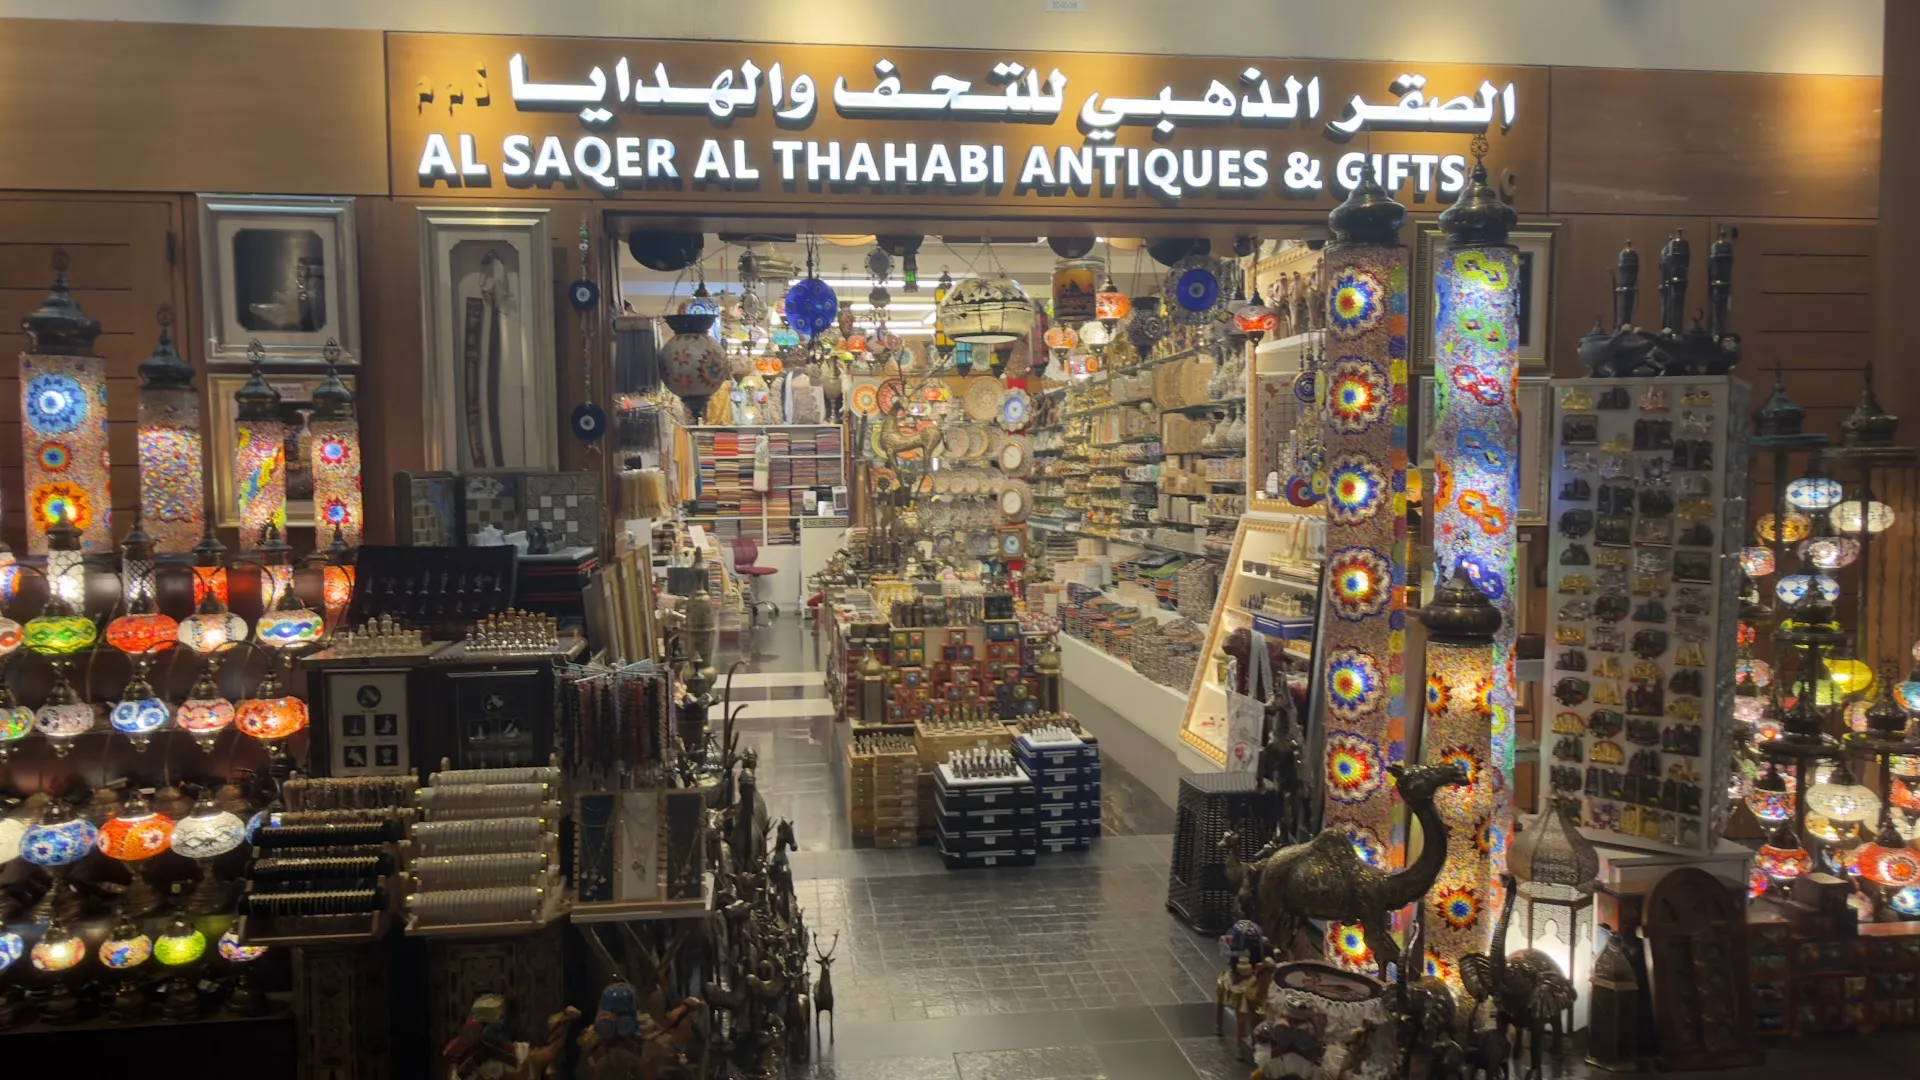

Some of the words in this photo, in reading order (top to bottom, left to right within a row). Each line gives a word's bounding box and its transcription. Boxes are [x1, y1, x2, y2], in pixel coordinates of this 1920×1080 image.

[509, 53, 815, 122] والهدايا
[833, 58, 1068, 112] للتحف
[1081, 67, 1320, 140] الذهبي
[1331, 73, 1516, 133] الصقر
[418, 133, 487, 175] AL
[502, 134, 675, 187] SAQER
[693, 139, 759, 179] AL
[772, 140, 1004, 183] THAHABI
[1020, 145, 1269, 196] ANTIQUES
[1284, 151, 1323, 189] &
[1336, 152, 1465, 192] GIFTS
